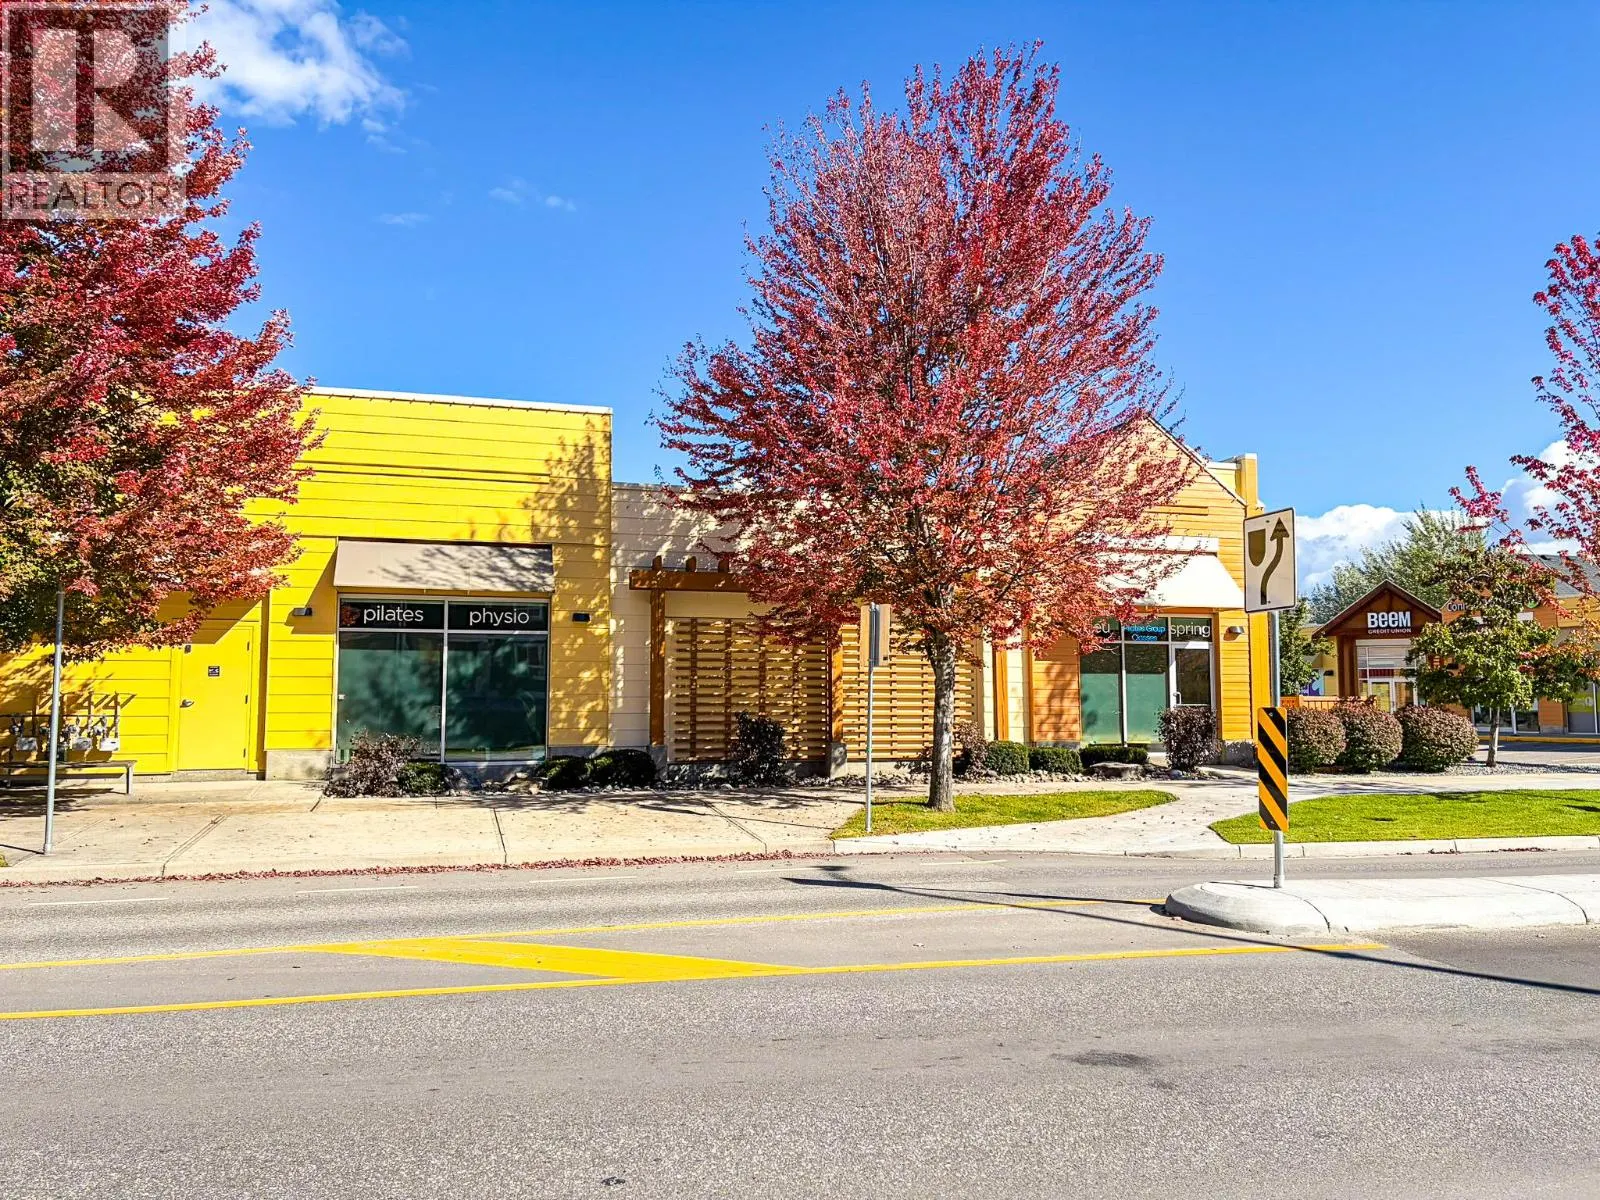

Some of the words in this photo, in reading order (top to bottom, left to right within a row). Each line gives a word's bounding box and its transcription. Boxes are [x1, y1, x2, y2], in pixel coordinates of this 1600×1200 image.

[363, 606, 424, 624] pilates
[469, 608, 530, 626] physio
[1171, 622, 1211, 638] spring
